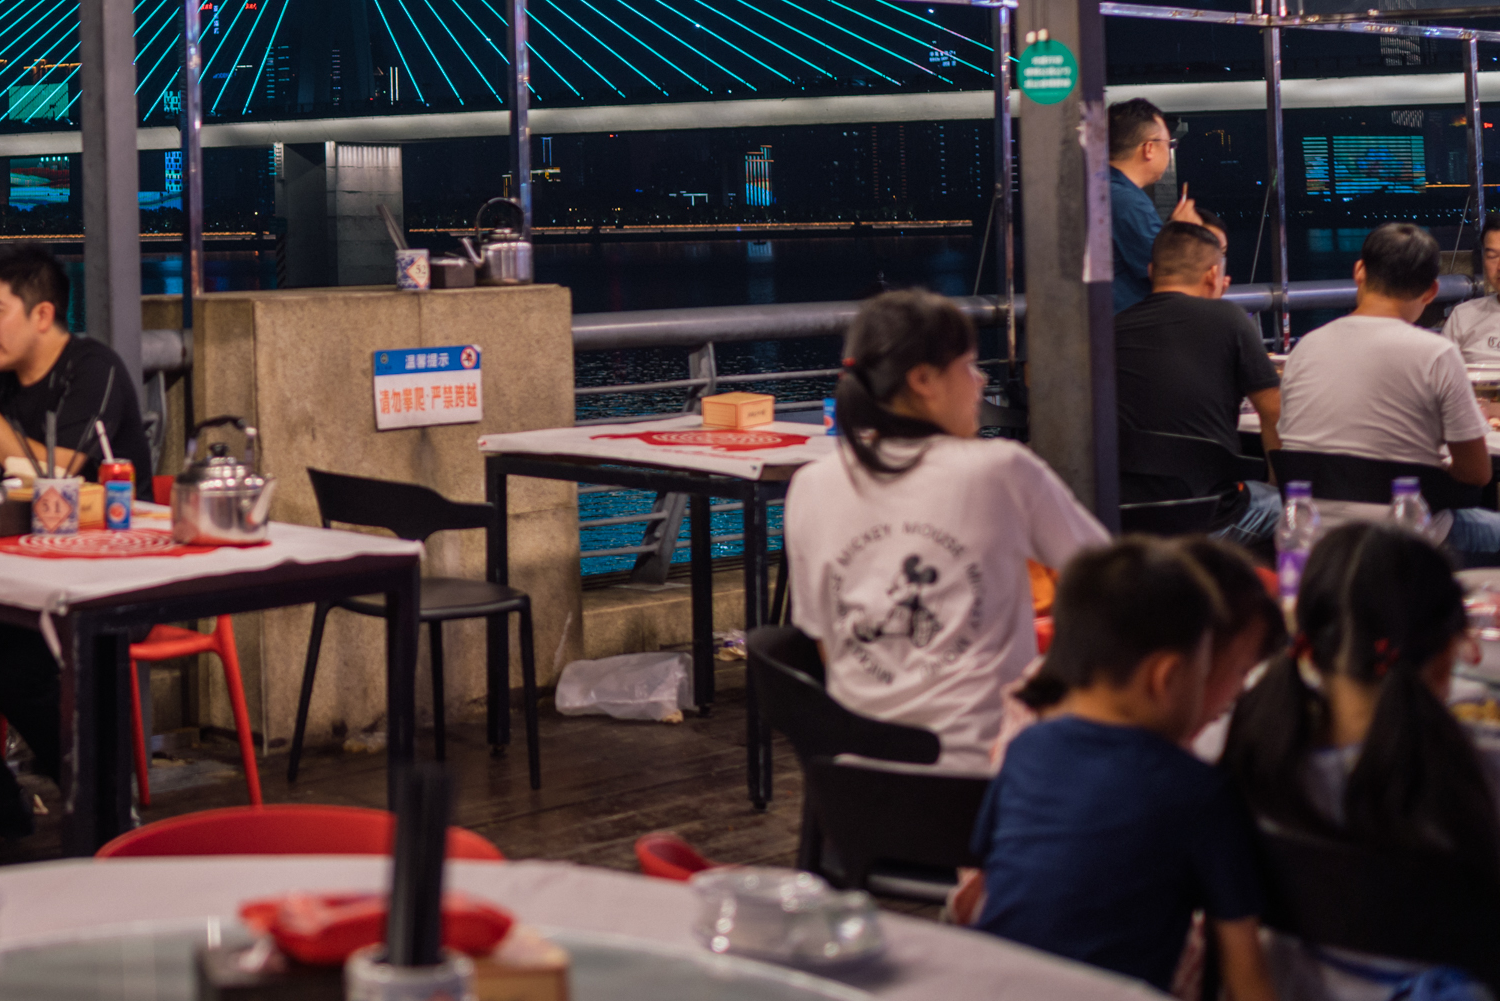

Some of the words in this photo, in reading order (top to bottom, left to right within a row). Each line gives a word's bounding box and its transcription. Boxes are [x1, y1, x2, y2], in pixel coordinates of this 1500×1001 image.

[415, 264, 427, 275] 52
[404, 352, 449, 370] 温馨提示
[836, 524, 891, 566] MICKEY
[903, 521, 964, 557] MOUSE
